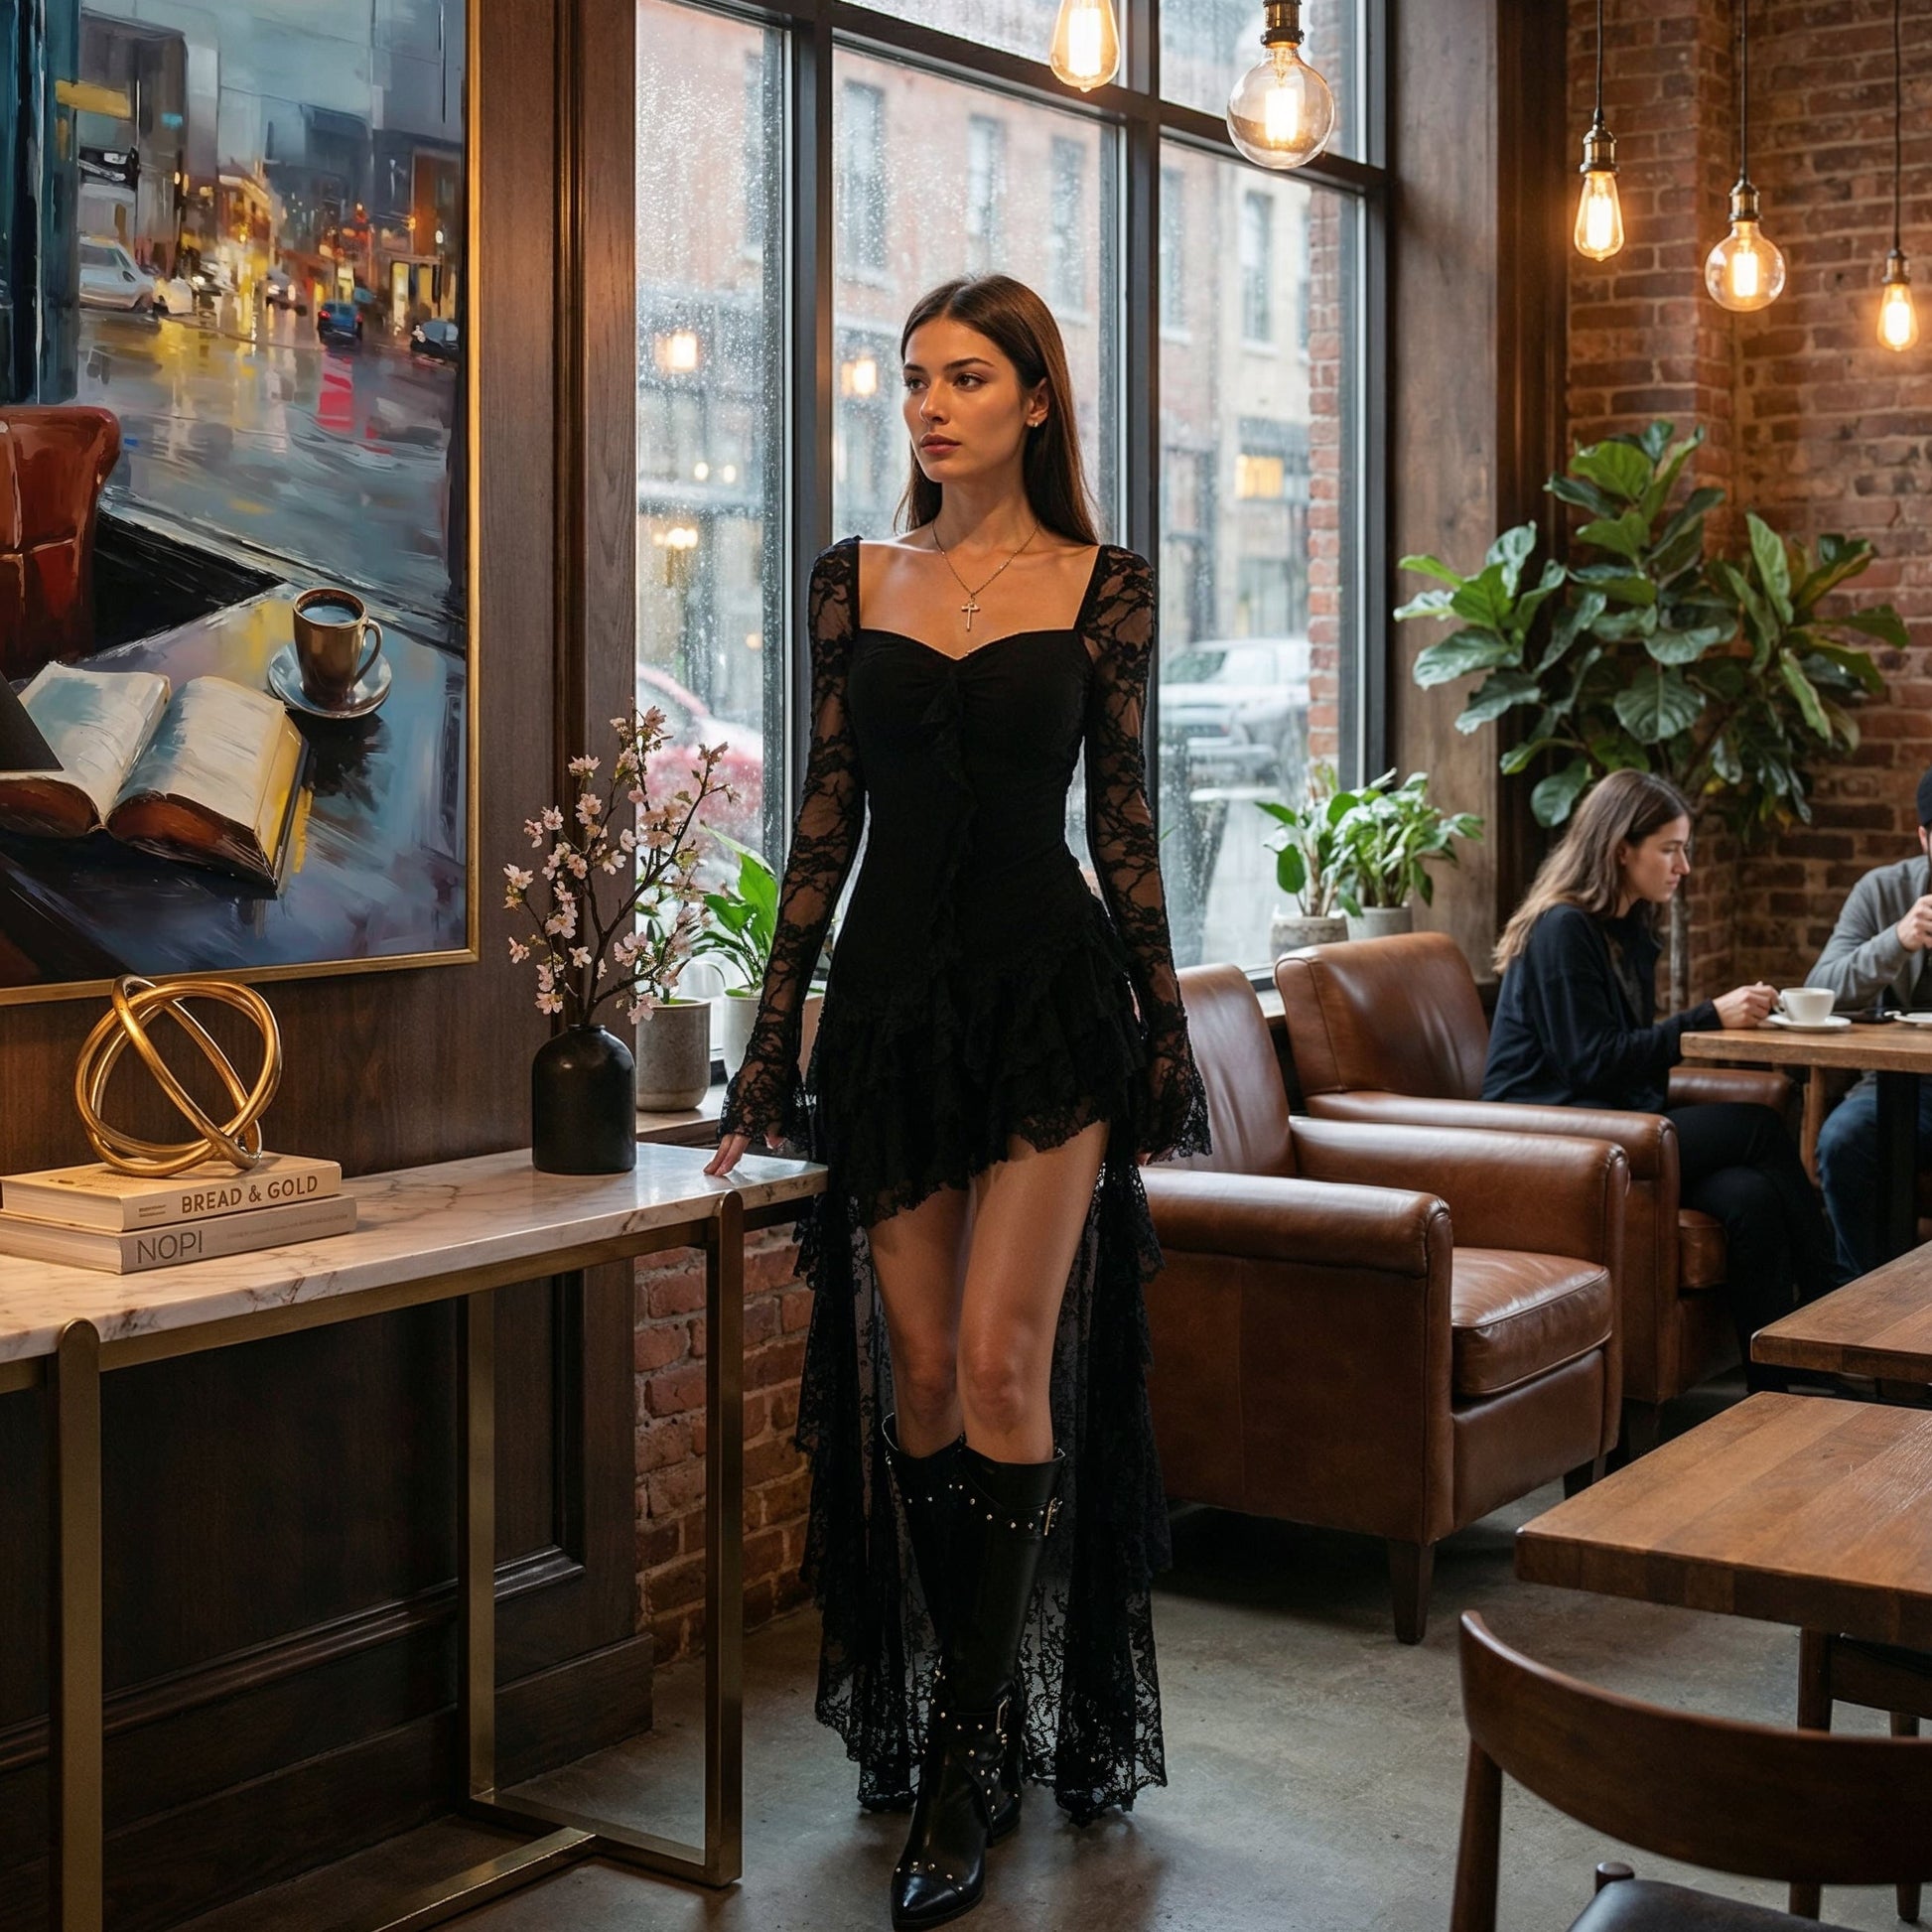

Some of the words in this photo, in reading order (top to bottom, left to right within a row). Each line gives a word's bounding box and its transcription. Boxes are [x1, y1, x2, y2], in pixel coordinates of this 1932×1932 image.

[182, 1188, 242, 1213] BREAD
[248, 1184, 262, 1202] &
[267, 1175, 318, 1199] GOLD
[137, 1230, 203, 1264] NOPI
